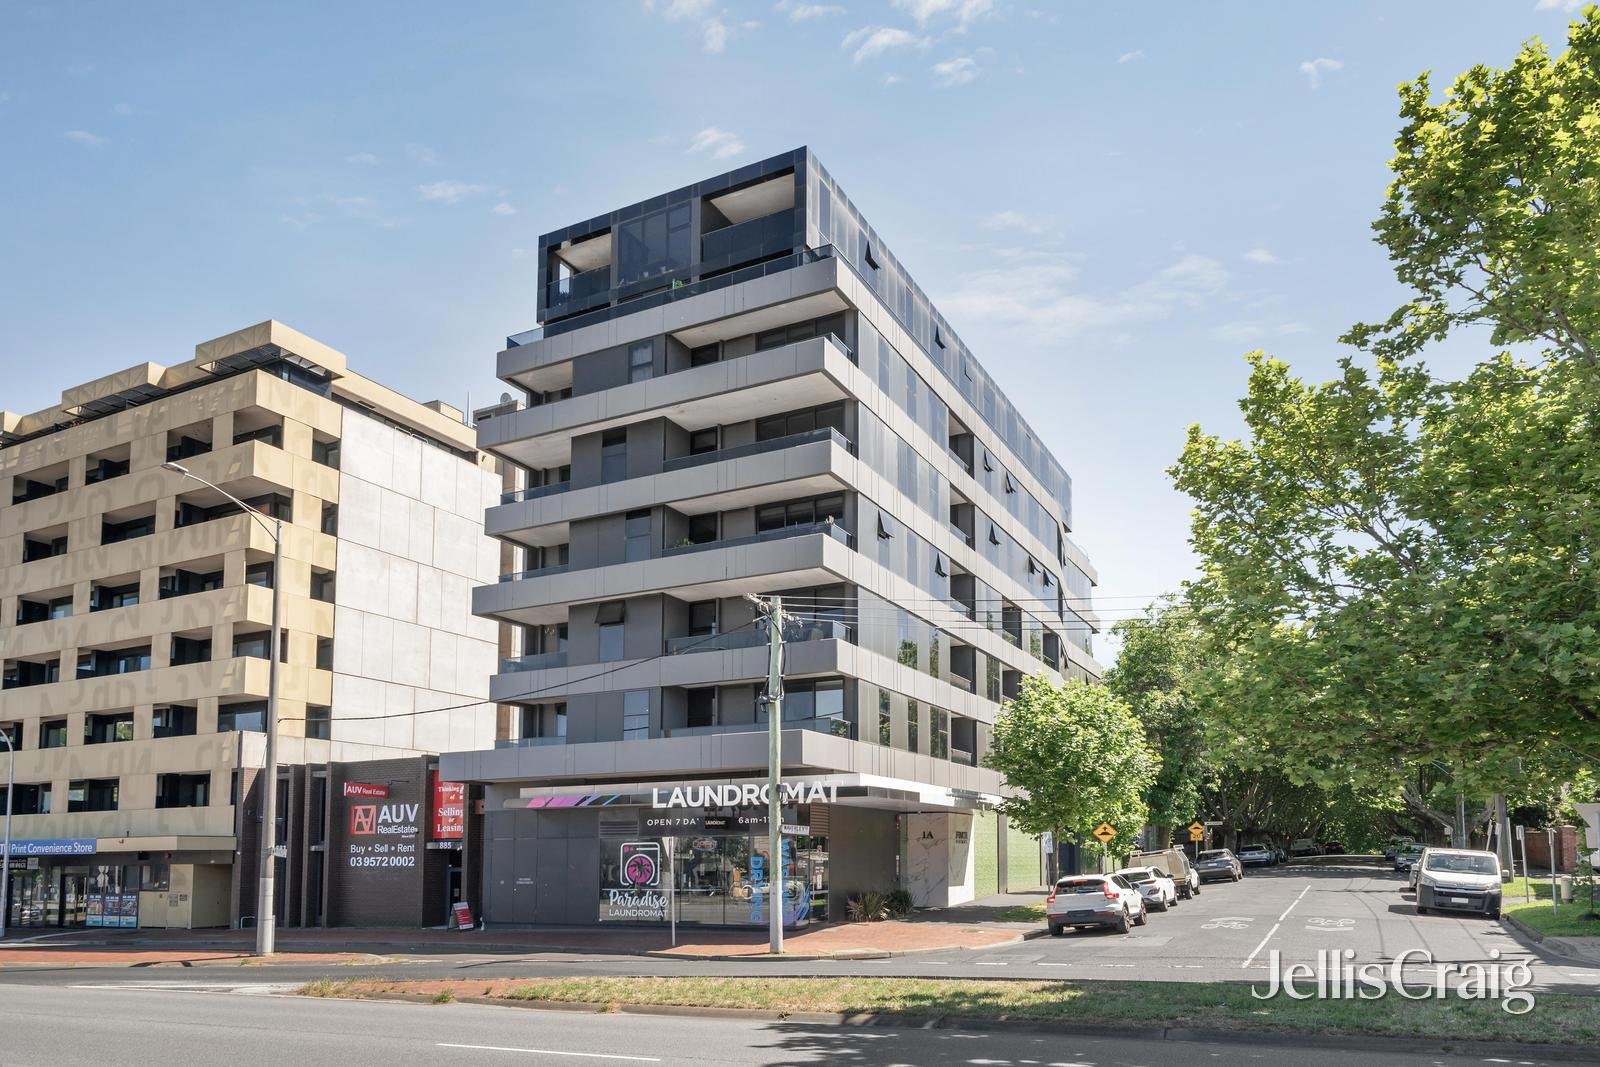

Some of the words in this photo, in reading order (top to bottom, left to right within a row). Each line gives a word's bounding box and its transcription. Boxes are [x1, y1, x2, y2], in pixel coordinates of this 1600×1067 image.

[347, 785, 362, 794] AUV
[378, 803, 419, 823] AUV
[647, 818, 671, 827] OPEN
[675, 818, 681, 826] 7
[683, 817, 700, 826] DA
[377, 825, 415, 834] RealEstate
[11, 843, 27, 853] Print
[27, 842, 72, 853] Convenience
[73, 842, 92, 852] Store
[350, 844, 366, 854] Buy
[374, 844, 388, 852] Sell
[397, 844, 415, 852] Rent
[350, 857, 362, 867] 03
[363, 857, 388, 867] 9572
[389, 856, 415, 867] 0002
[609, 889, 668, 909] Paradise
[609, 909, 668, 917] LAUNDROMAT
